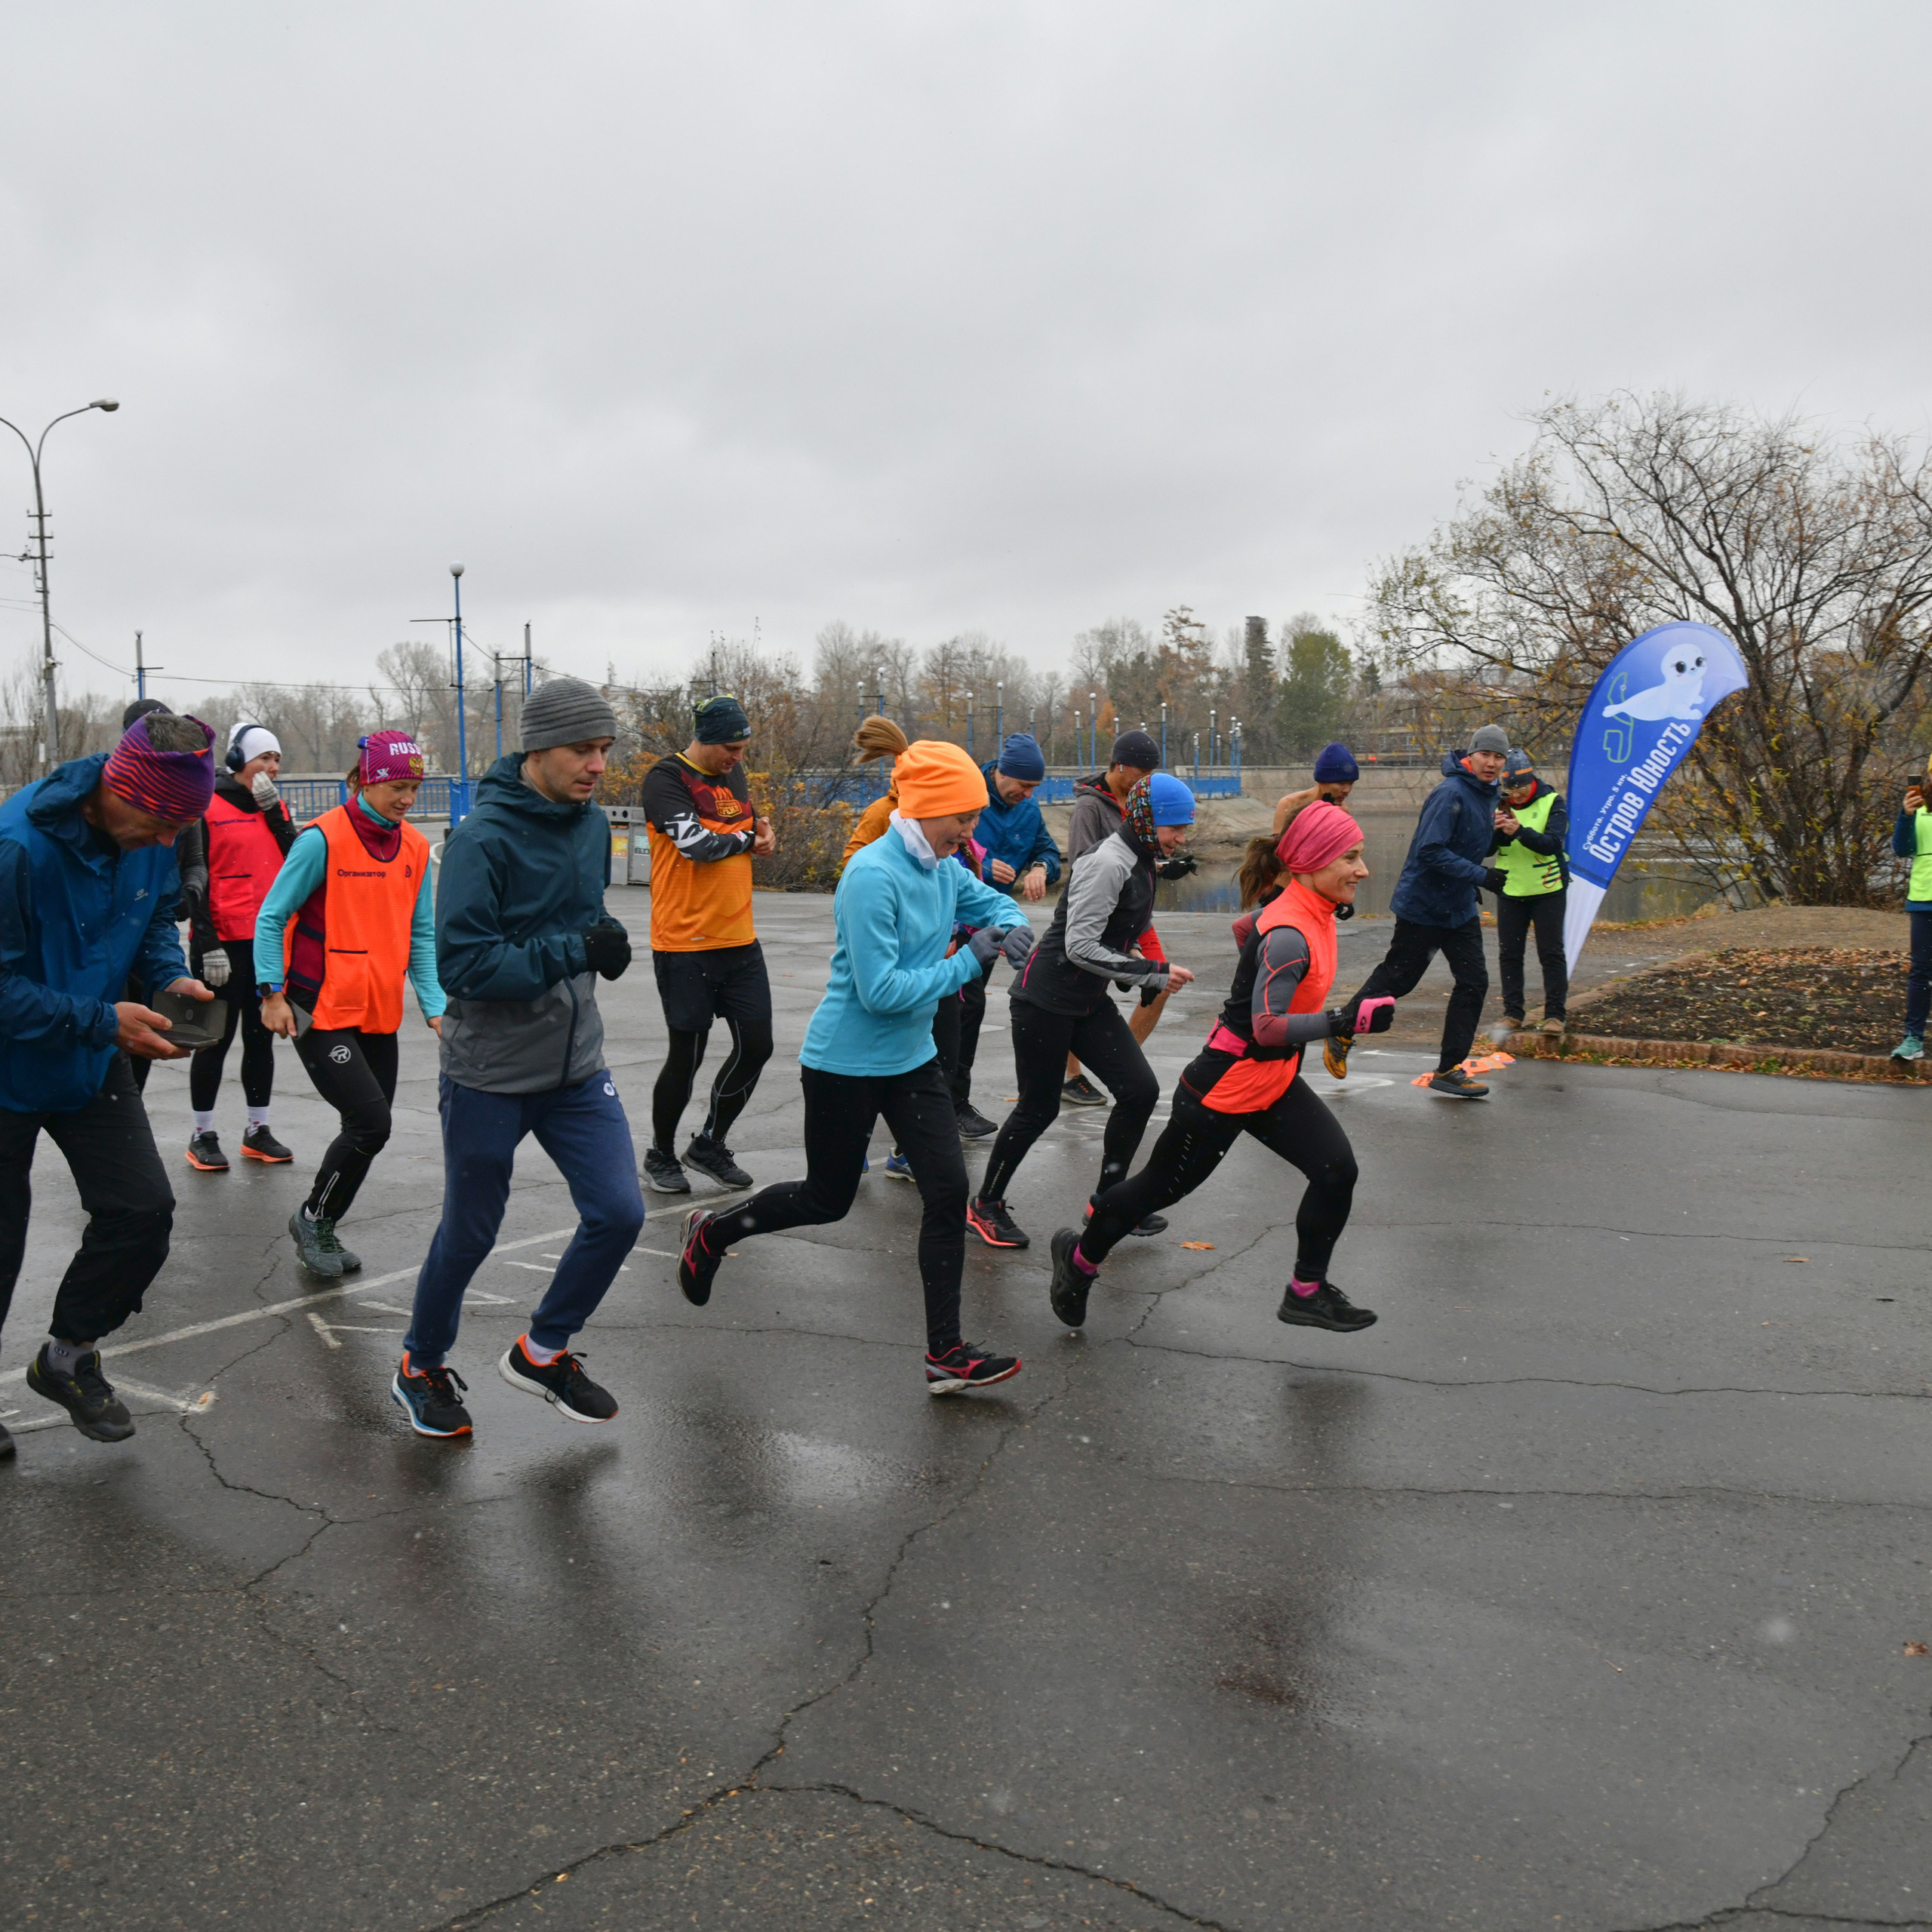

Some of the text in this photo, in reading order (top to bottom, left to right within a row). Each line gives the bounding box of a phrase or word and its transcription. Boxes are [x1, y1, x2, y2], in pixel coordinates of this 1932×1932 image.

[1589, 722, 1691, 864] Остров Юность
[1583, 817, 1604, 850] Суббота.
[1600, 794, 1616, 814] Утро.
[337, 869, 386, 878] Организатор
